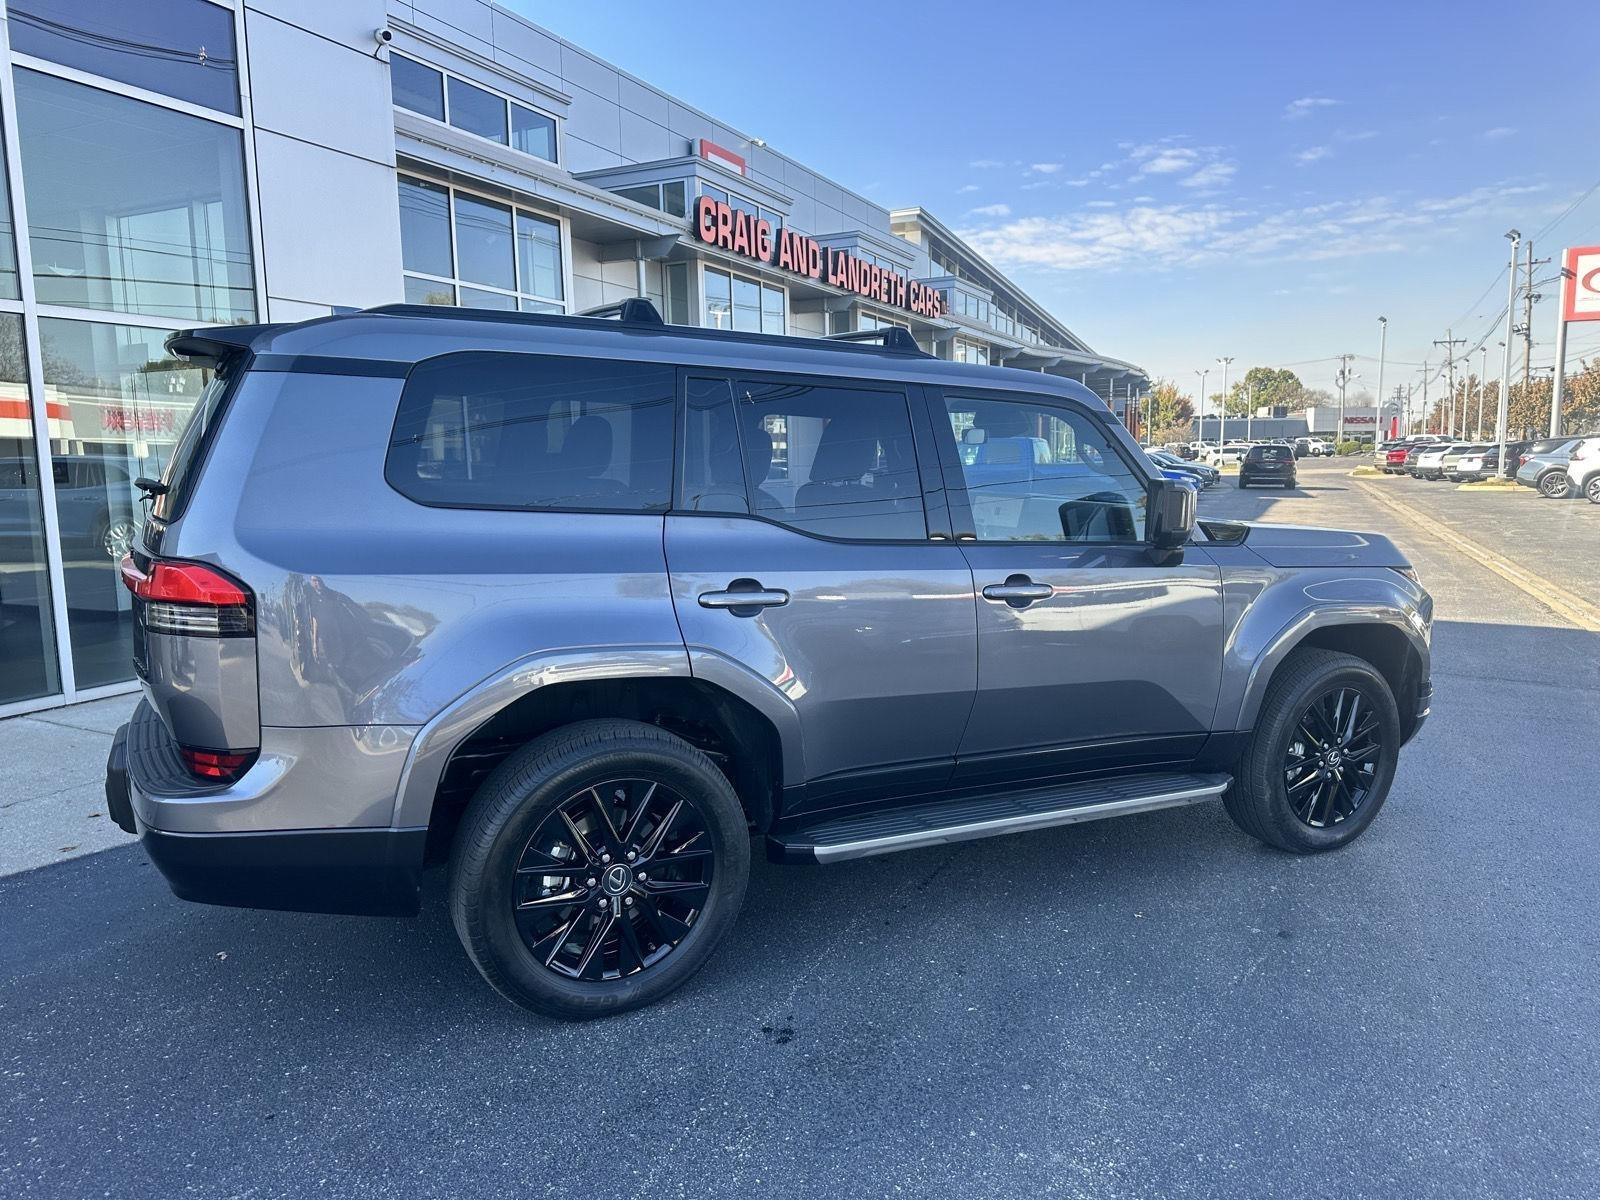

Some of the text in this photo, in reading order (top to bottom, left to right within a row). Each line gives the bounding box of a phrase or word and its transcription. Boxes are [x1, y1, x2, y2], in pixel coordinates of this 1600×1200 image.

[697, 195, 941, 319] CRAIG AND LANDRETH CARS
